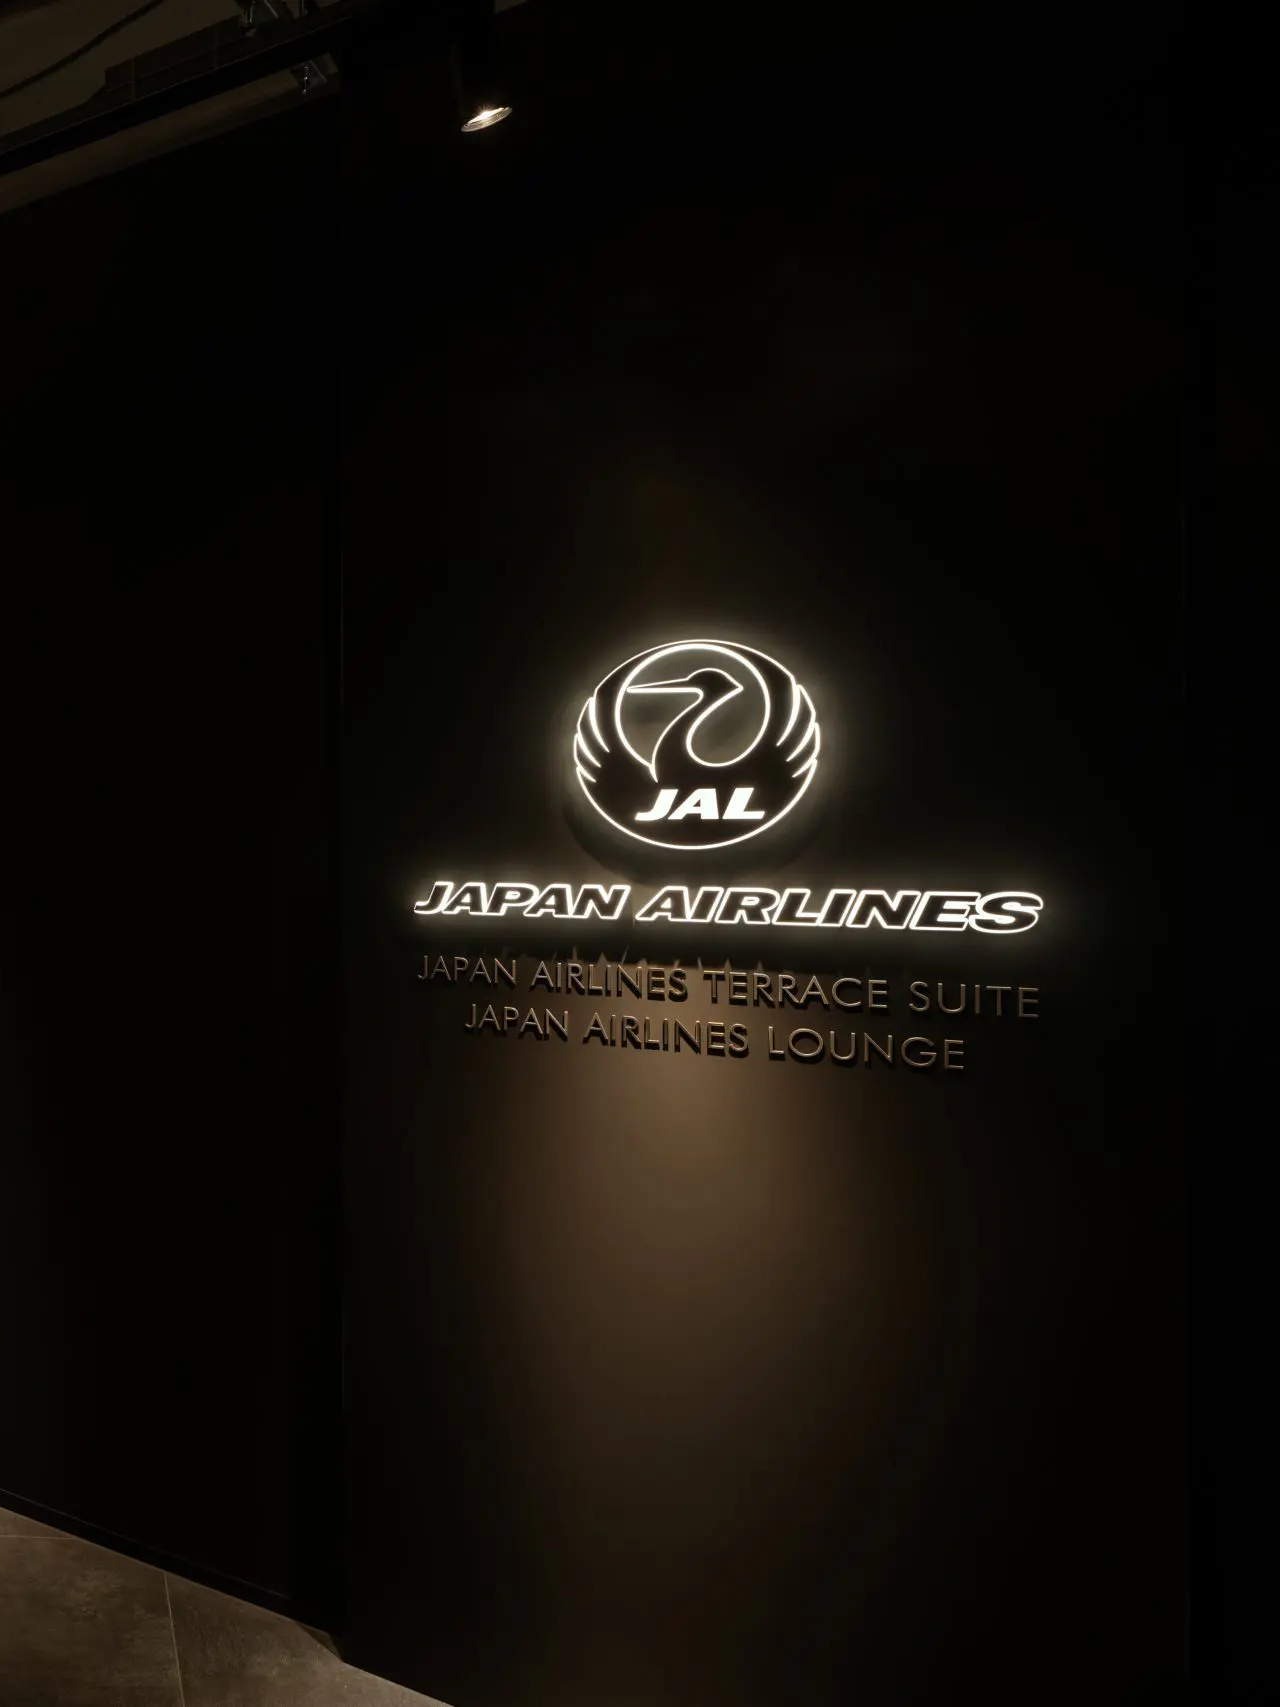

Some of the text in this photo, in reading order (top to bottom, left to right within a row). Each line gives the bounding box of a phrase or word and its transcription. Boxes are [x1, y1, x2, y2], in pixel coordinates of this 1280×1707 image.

[635, 788, 765, 820] JAL
[414, 881, 1044, 933] JAPAN AIRLINES
[418, 955, 1040, 1018] JAPAN AIRLINES TERRACE SUITE
[465, 1003, 965, 1070] JAPAN AIRLINES LOUNGE
